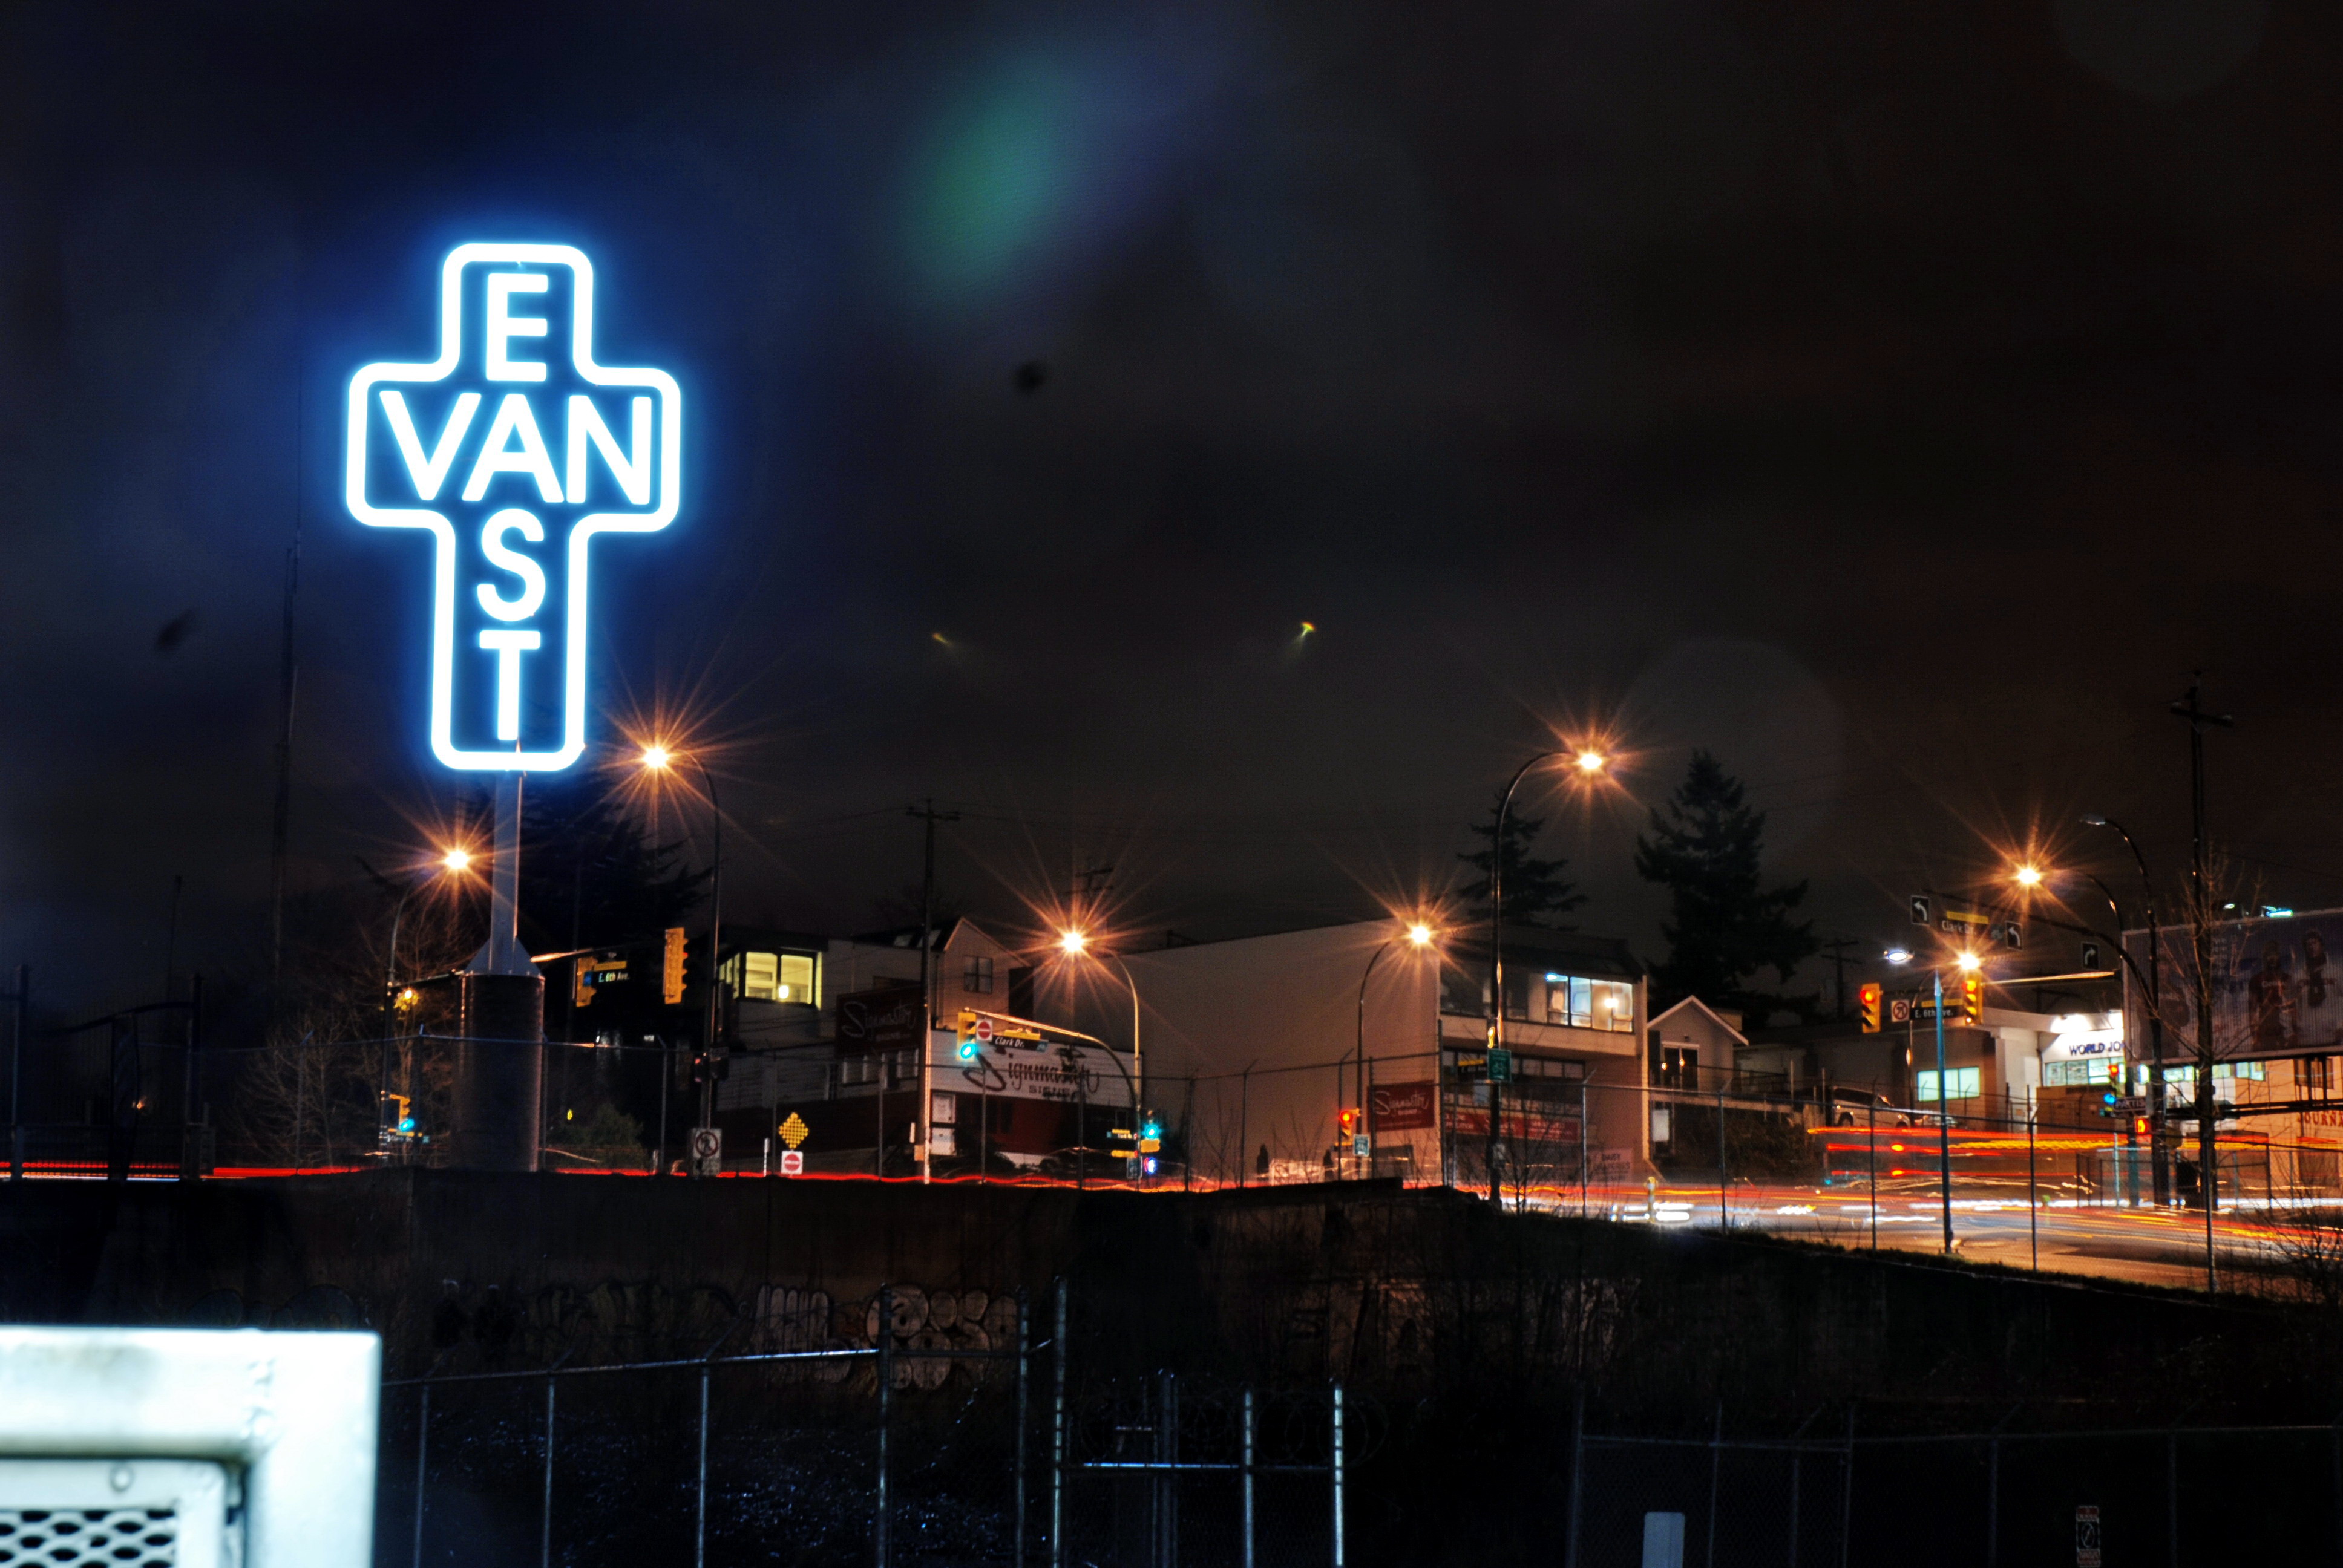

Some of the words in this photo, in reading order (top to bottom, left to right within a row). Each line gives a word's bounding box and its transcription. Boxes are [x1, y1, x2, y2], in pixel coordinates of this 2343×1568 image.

[379, 390, 652, 505] VAN
[1915, 1009, 1921, 1018] E.
[1923, 1008, 1936, 1018] 6th
[995, 1036, 1014, 1046] Clark
[1014, 1039, 1024, 1048] Dr.
[2069, 1042, 2105, 1056] WORLD
